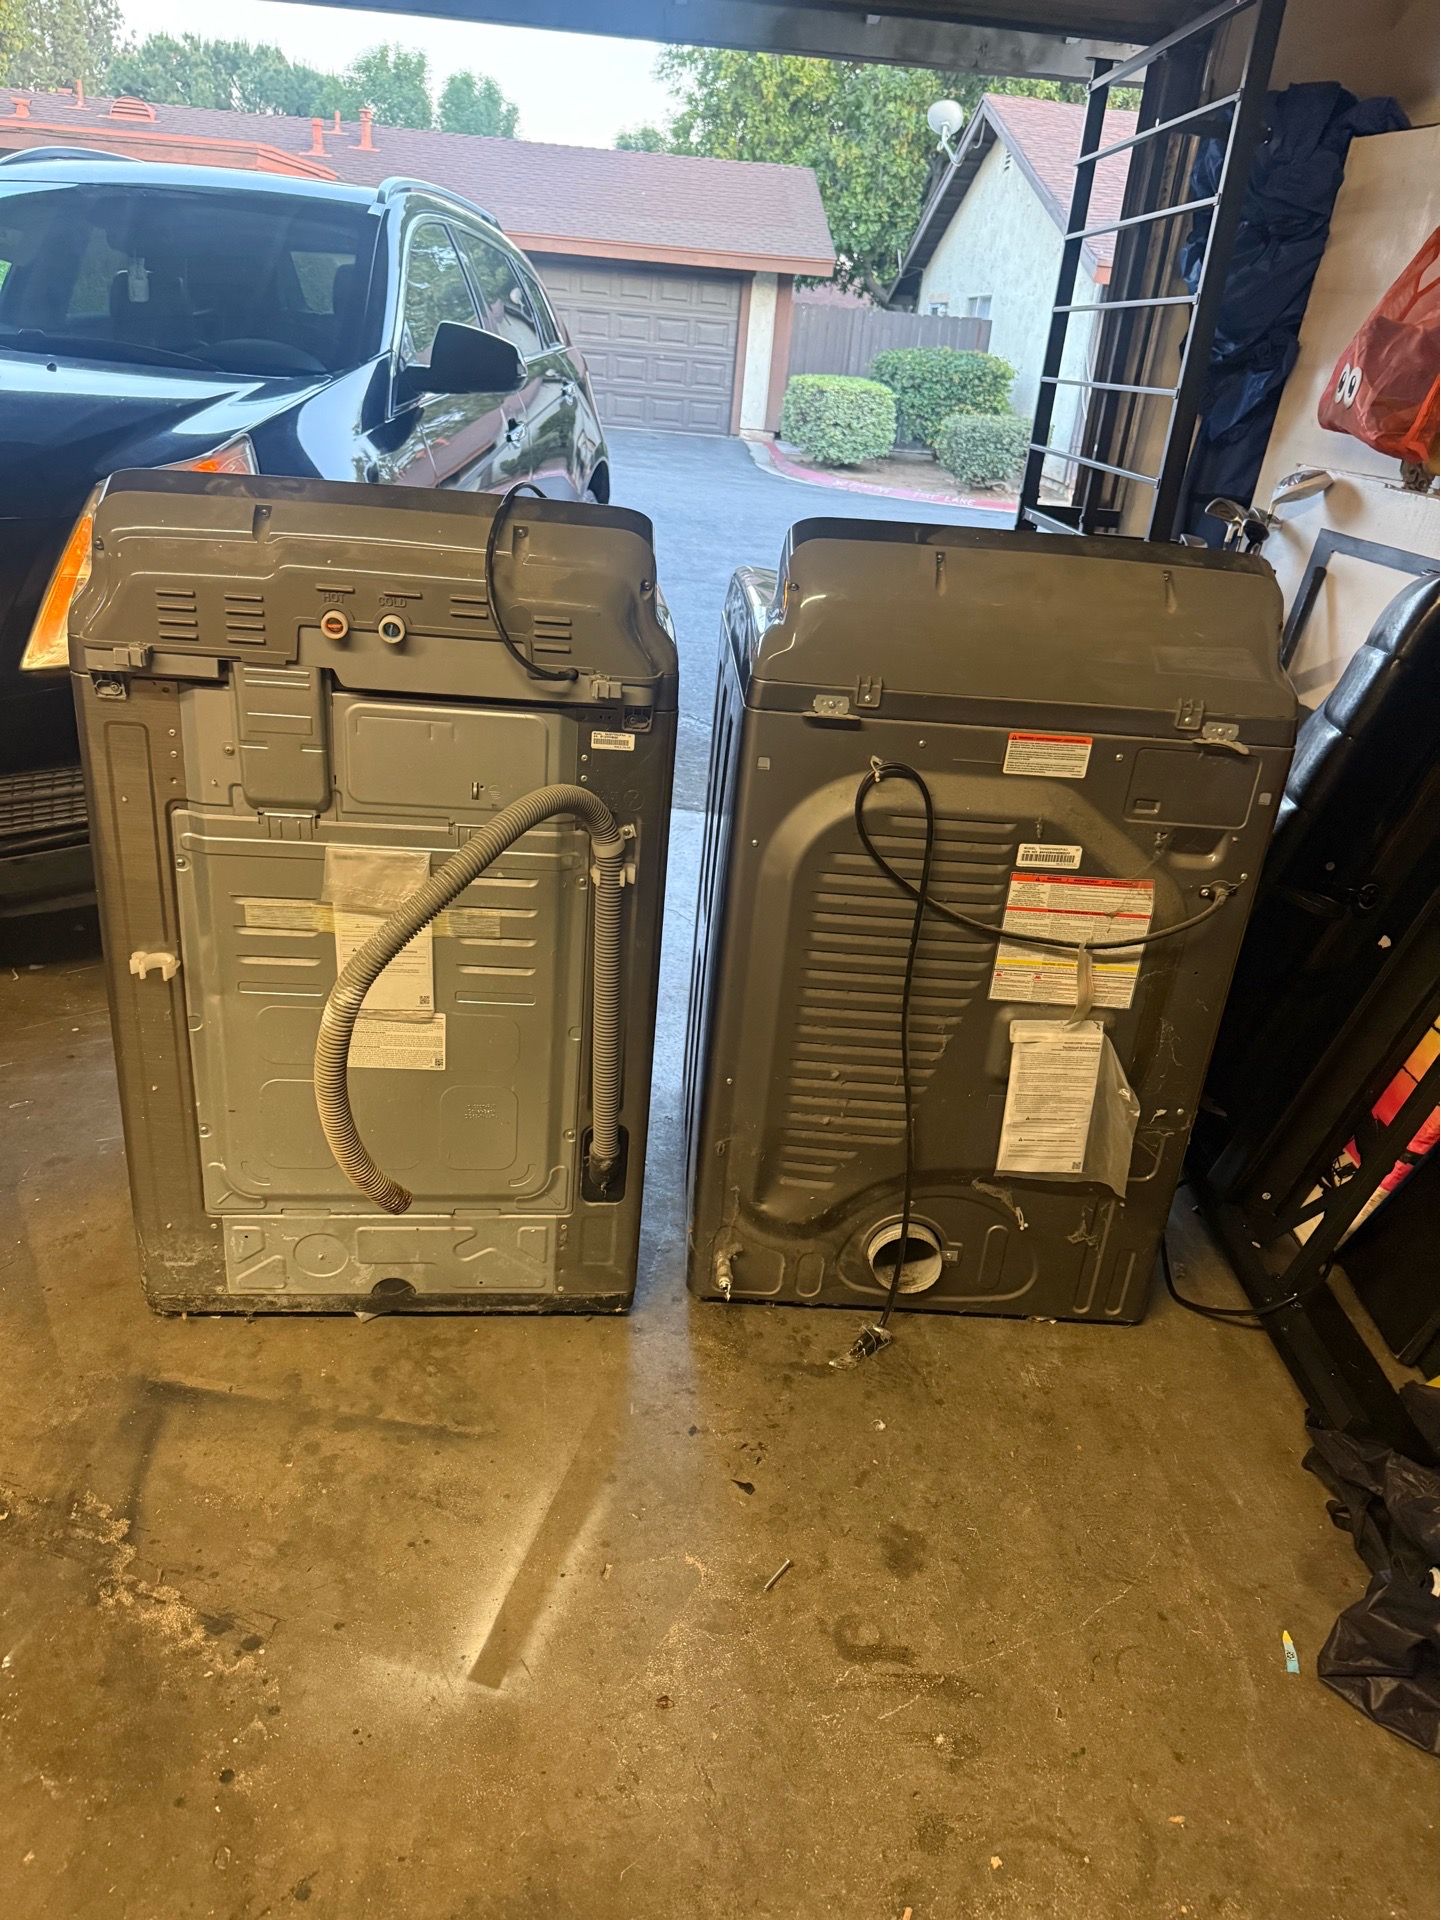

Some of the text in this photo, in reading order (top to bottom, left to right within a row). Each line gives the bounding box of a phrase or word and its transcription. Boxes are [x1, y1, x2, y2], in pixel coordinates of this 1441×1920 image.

[944, 495, 977, 506] LANE
[323, 592, 345, 604] HOT
[378, 596, 407, 608] COLD
